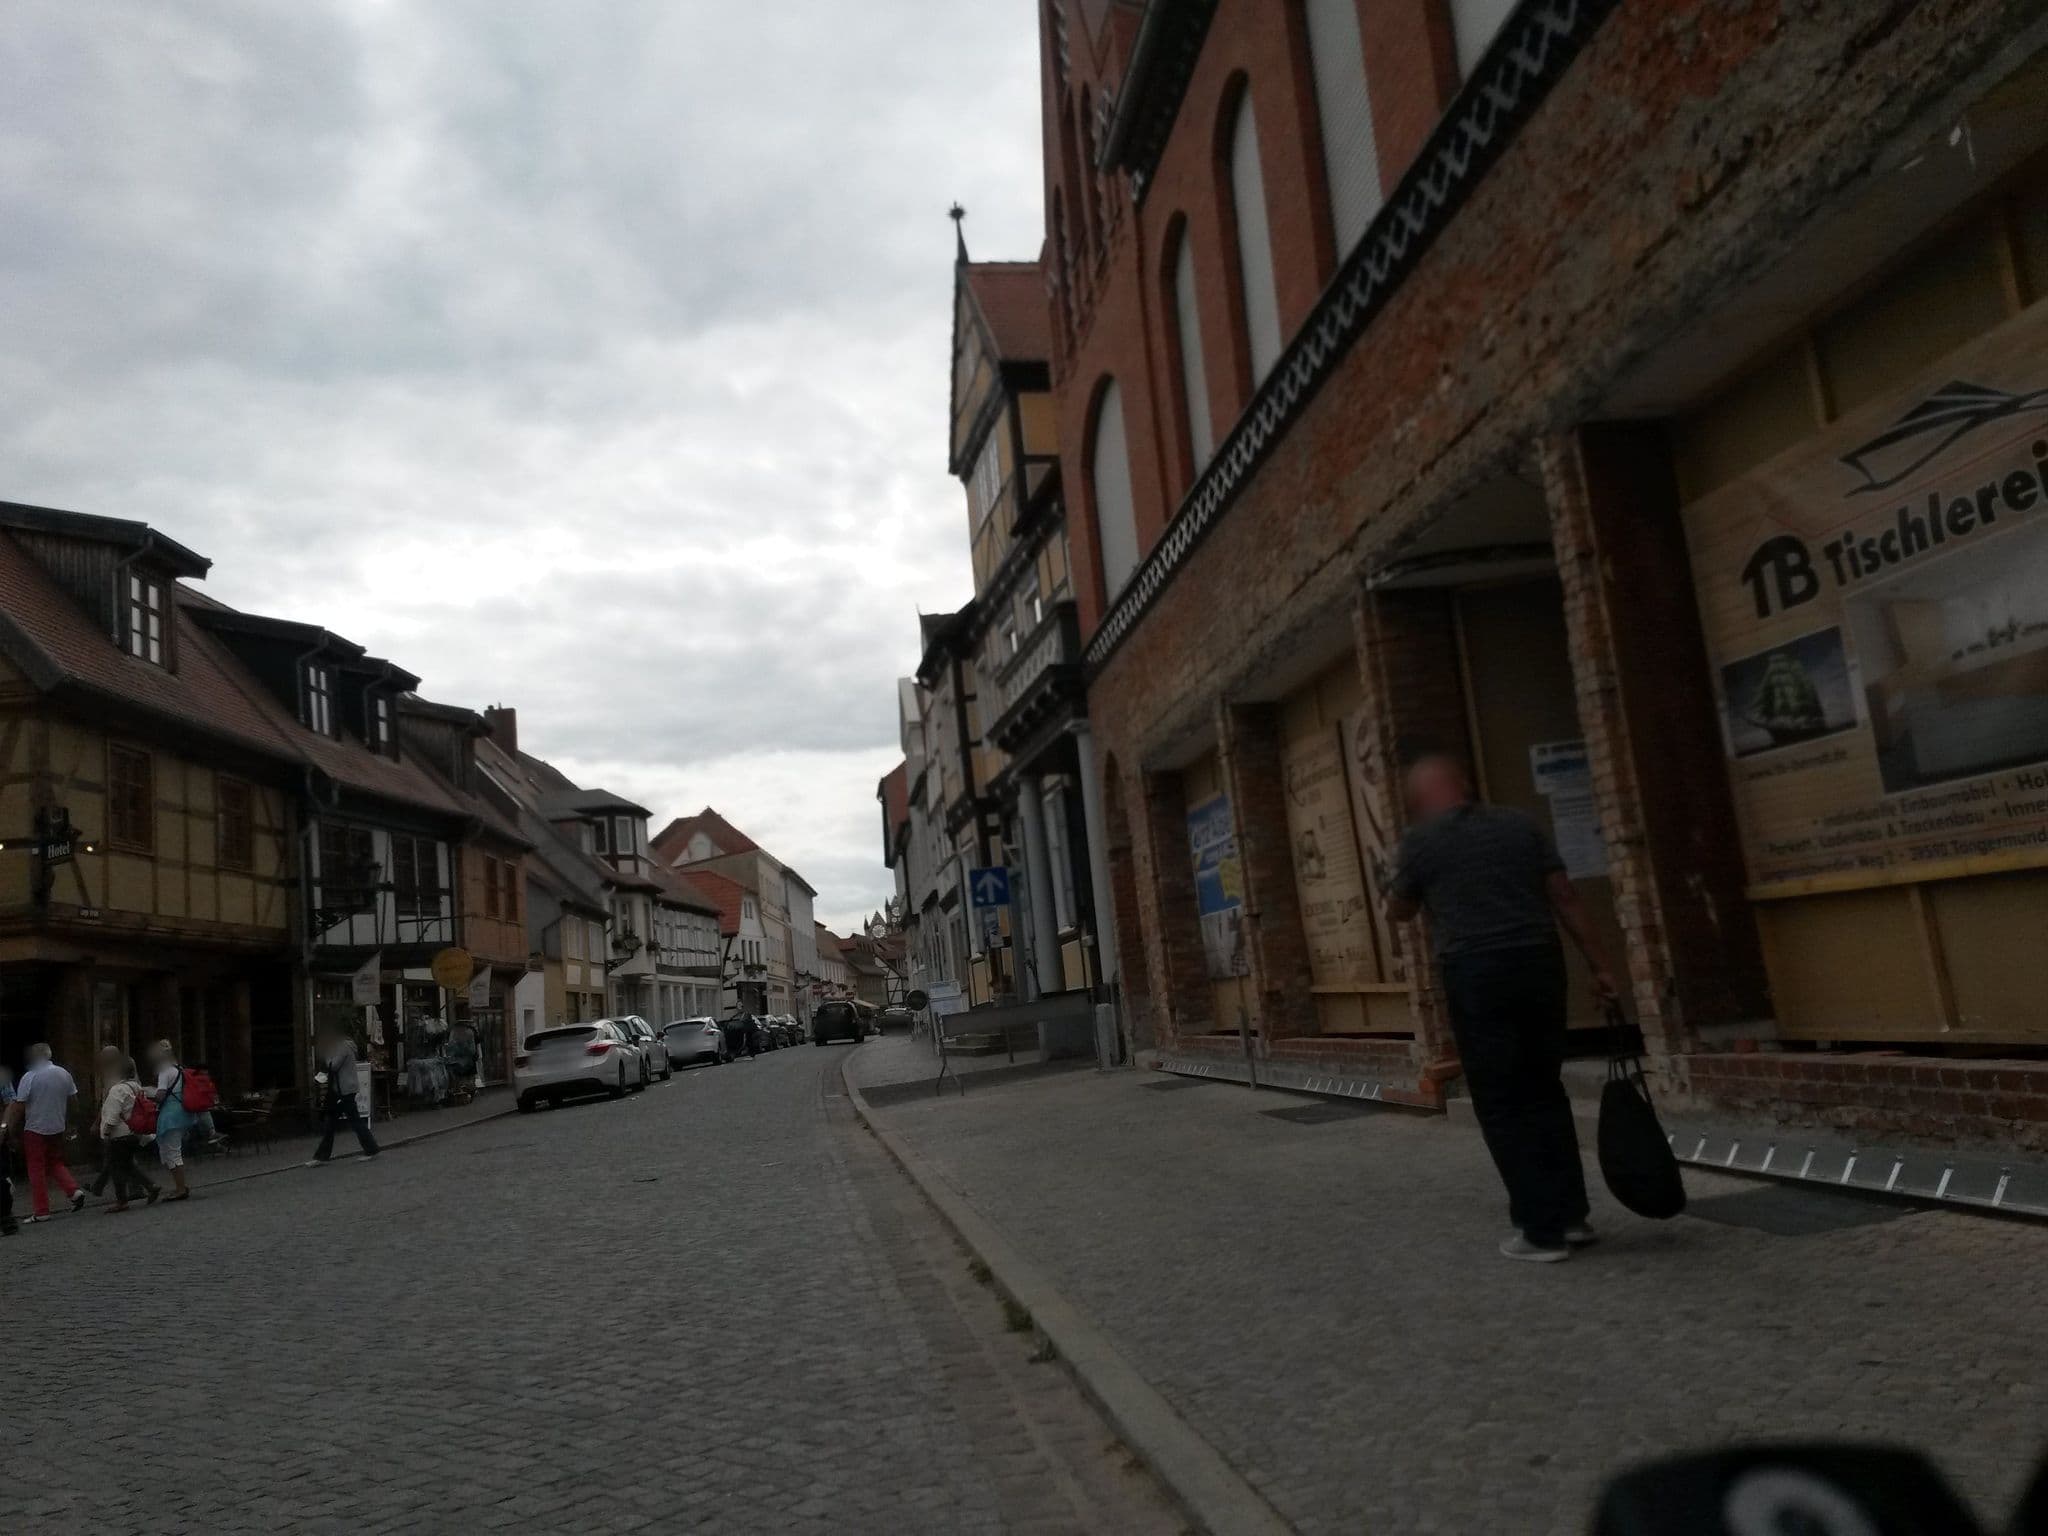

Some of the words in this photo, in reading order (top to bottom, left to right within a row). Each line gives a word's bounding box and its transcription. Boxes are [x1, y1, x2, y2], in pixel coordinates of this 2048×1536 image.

[1824, 439, 2048, 586] Tischlerei
[1742, 535, 1820, 619] TB
[47, 841, 71, 859] Hotel
